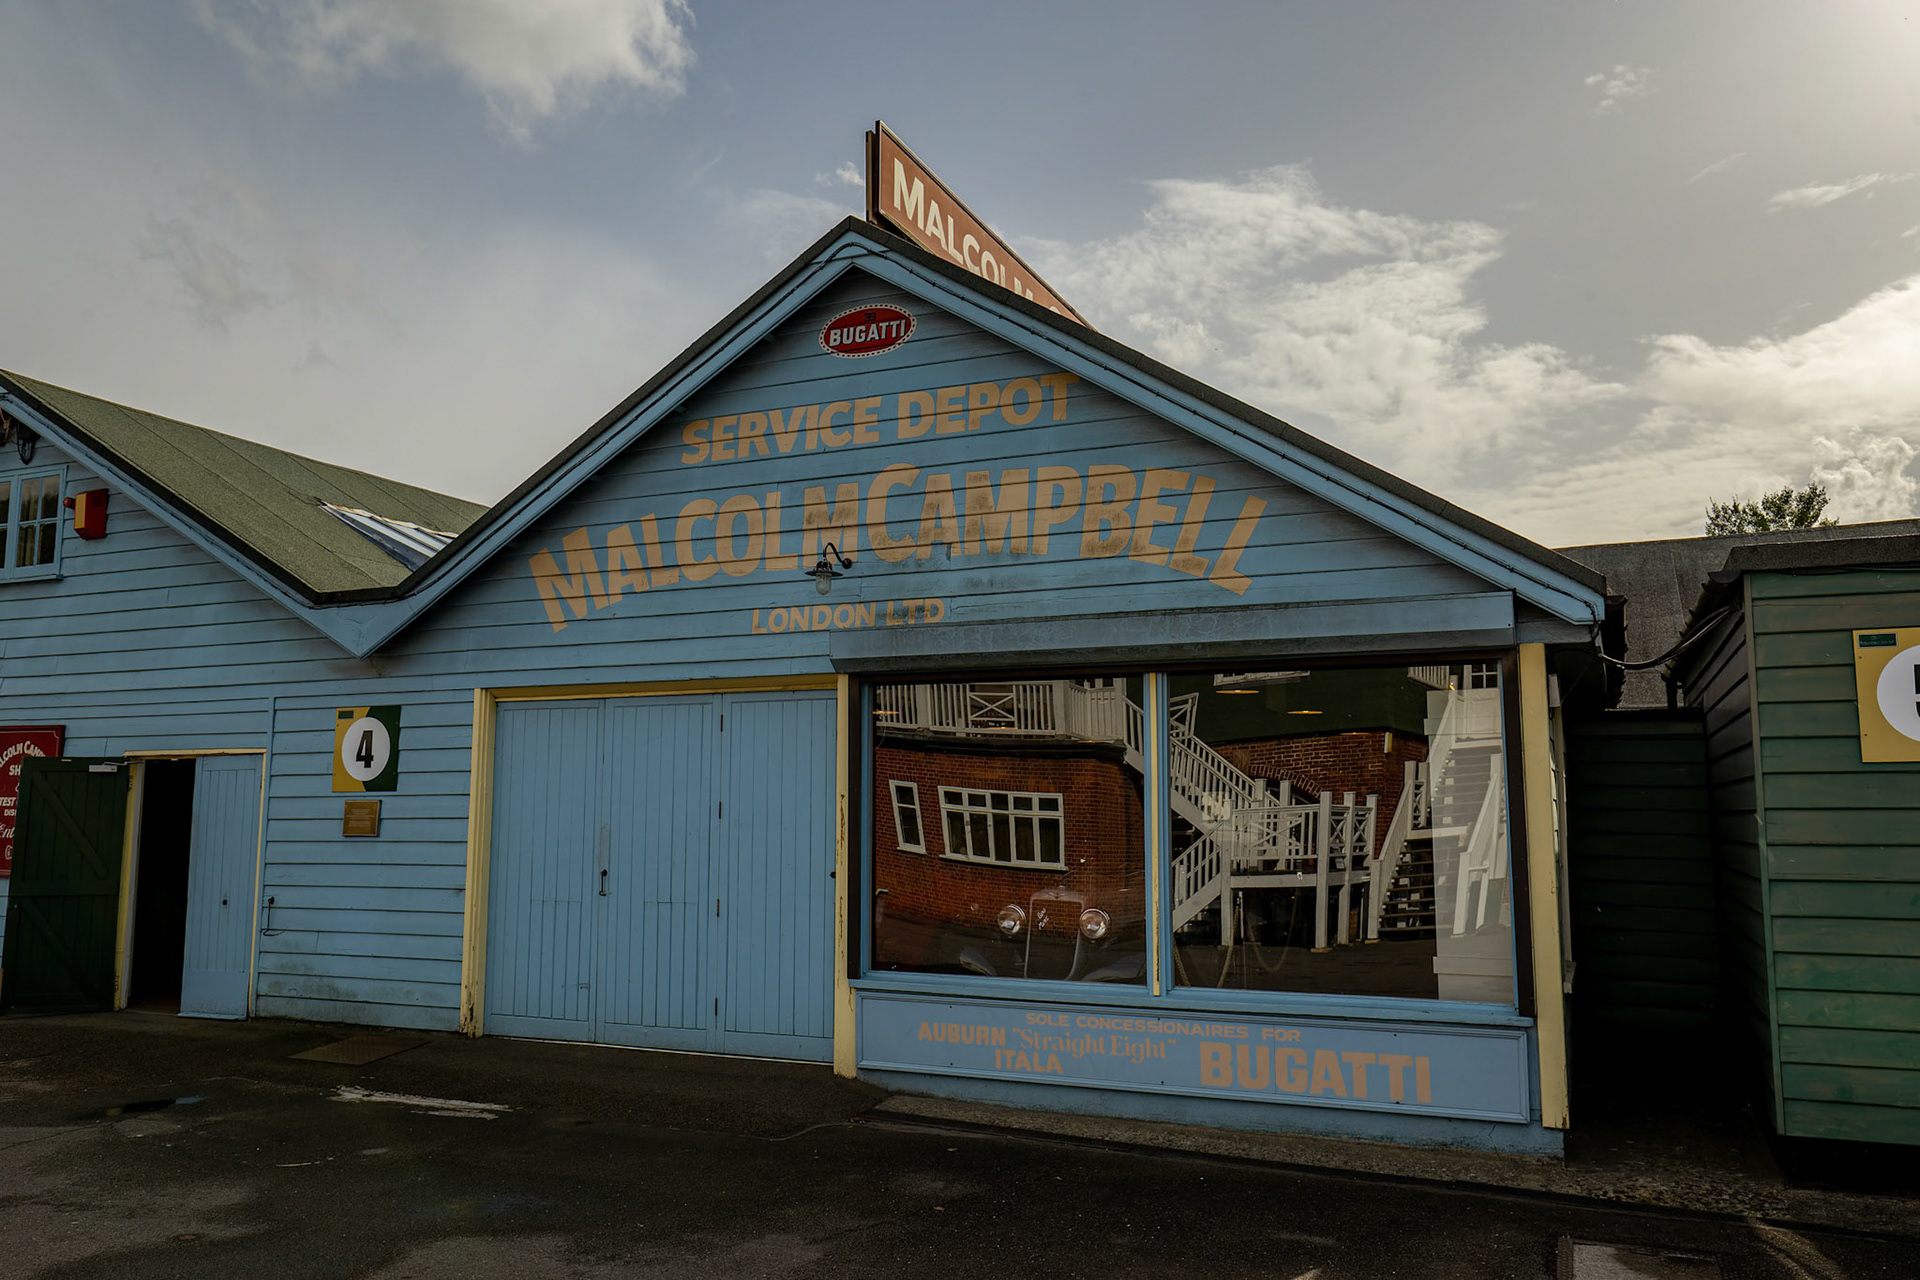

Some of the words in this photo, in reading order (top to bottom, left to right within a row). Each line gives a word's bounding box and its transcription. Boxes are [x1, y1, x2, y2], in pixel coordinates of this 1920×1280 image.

[829, 321, 906, 347] BUGATTI
[680, 396, 882, 464] SERVICE
[898, 372, 1080, 439] DEPOT
[528, 482, 859, 633] MALCOLM
[866, 463, 1268, 596] CAMPBELL
[751, 600, 876, 635] LONDON
[886, 597, 945, 626] LTD
[356, 730, 374, 768] 4
[918, 1022, 1005, 1046] AUBURN
[1026, 1013, 1069, 1026] SOLE
[1077, 1016, 1248, 1039] CONCESSIONAIRES
[1262, 1028, 1301, 1041] FOR
[996, 1049, 1063, 1073] ITALA
[1200, 1042, 1431, 1103] BUGATTI
